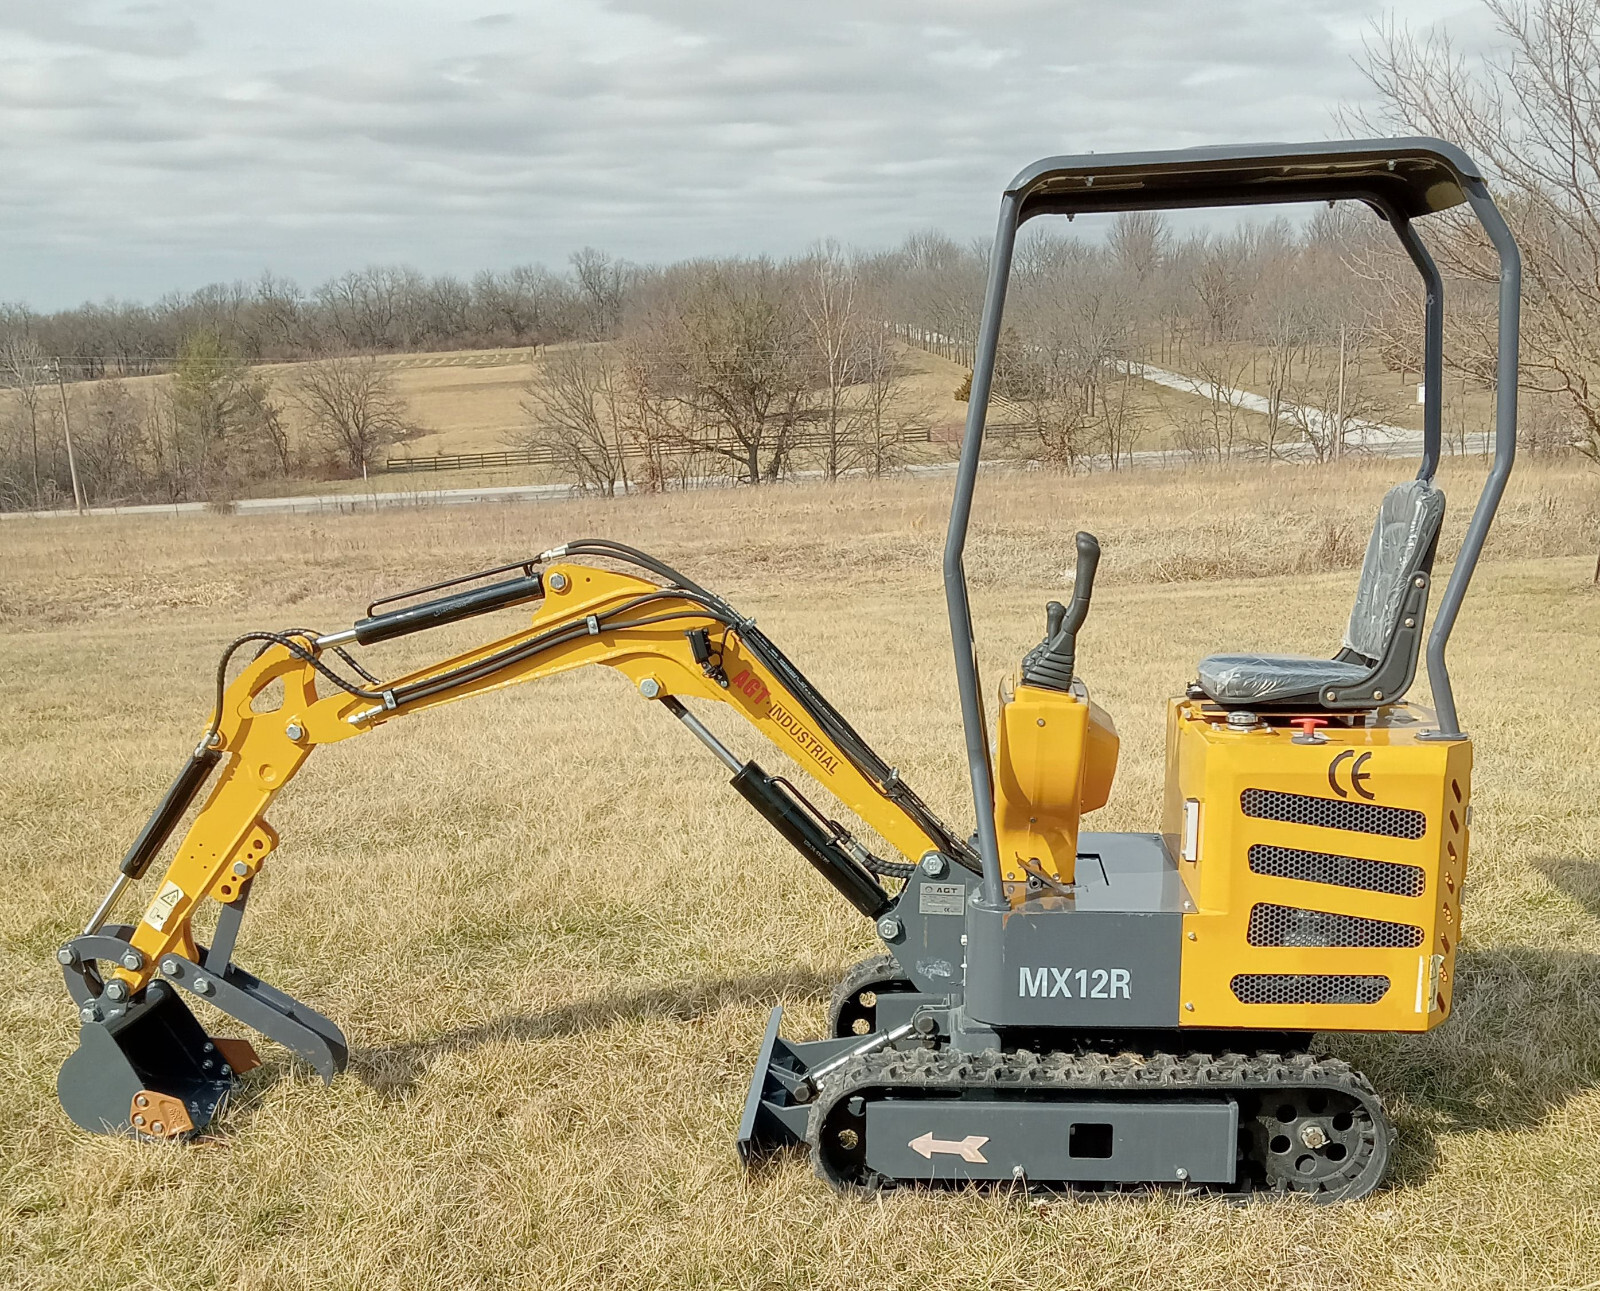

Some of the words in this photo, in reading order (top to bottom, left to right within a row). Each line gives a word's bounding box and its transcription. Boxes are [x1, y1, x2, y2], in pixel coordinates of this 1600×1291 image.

[731, 669, 772, 705] AGT
[767, 703, 839, 775] INDUSTRIAL
[1328, 749, 1376, 801] CE
[1019, 966, 1132, 1000] MX12R
